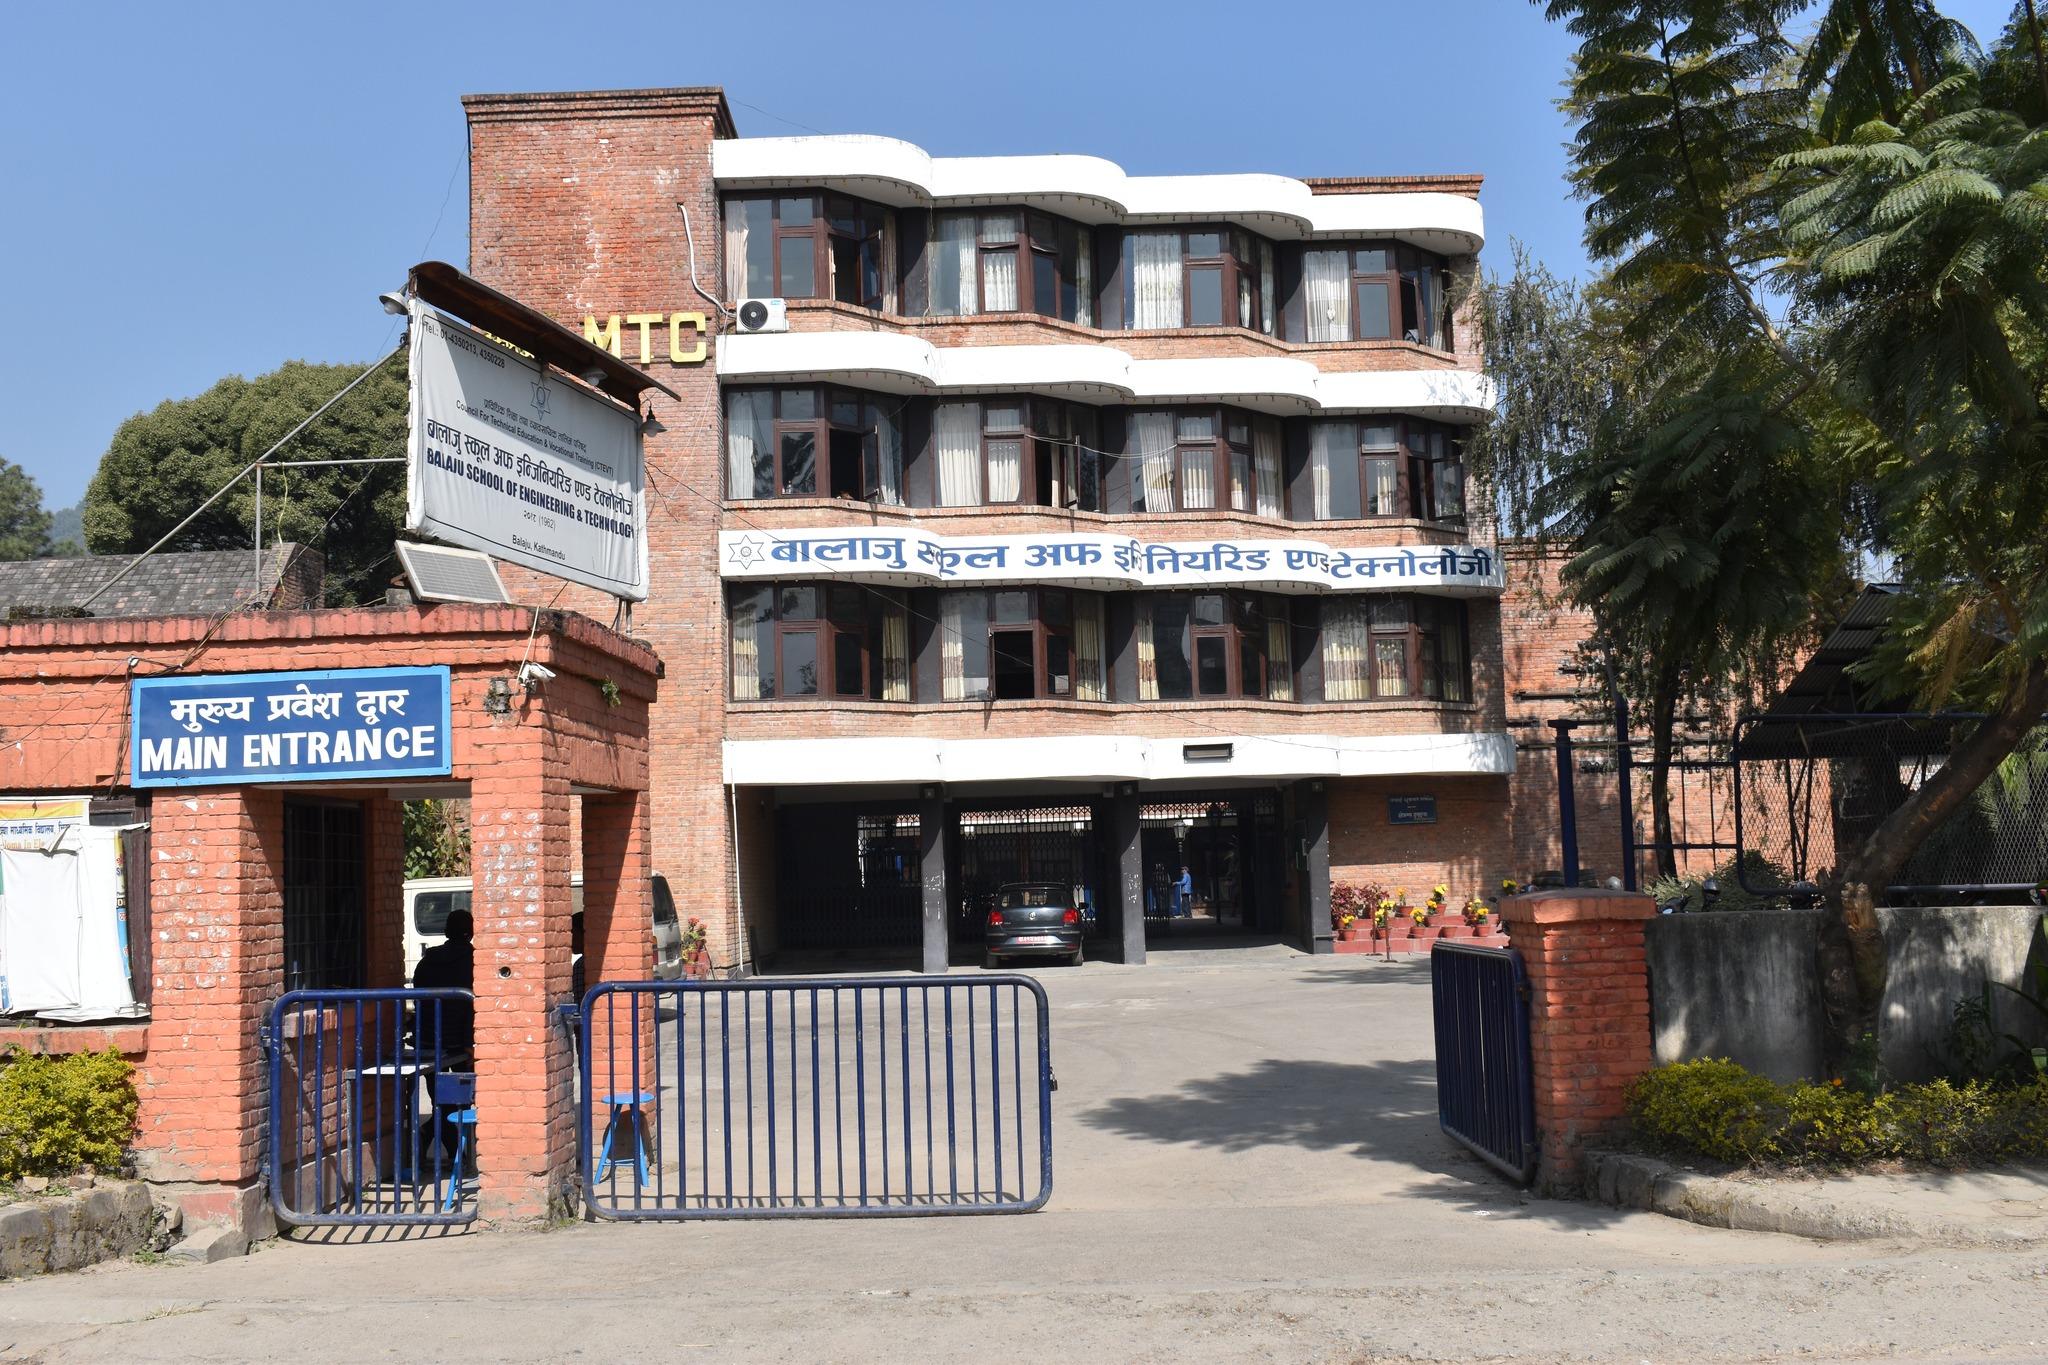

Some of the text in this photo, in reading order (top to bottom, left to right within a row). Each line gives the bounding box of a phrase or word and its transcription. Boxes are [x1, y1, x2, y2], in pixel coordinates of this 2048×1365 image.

[424, 322, 438, 336] Tel.:
[441, 329, 478, 358] 01-4350213,
[480, 349, 505, 368] 4350228
[584, 312, 706, 363] MTC
[428, 419, 461, 455] बालाजु
[464, 434, 490, 464] स्कूल
[494, 447, 514, 470] अफ
[574, 480, 591, 501] एण्ड
[456, 400, 613, 477] Council For Technical Education & Vocational Training (CTEVT)
[427, 448, 464, 476] BALAJU
[466, 464, 504, 493] SCHOOL
[506, 480, 517, 497] OF
[520, 485, 575, 519] ENGINEERING
[577, 510, 583, 522] &
[539, 515, 556, 532] (1962)
[512, 535, 565, 560] Balaju, Kathmandu
[771, 538, 906, 569] बालाजु
[918, 540, 1009, 577] स्कूल
[1025, 543, 1102, 568] अफ
[1283, 550, 1329, 574] एण्ड
[1331, 548, 1492, 578] टेक्नोलोजी
[267, 684, 343, 721] प्रवेश
[356, 689, 409, 726] द्वार
[141, 725, 435, 772] MAIN ENTRANCE
[34, 839, 45, 848] Ele
